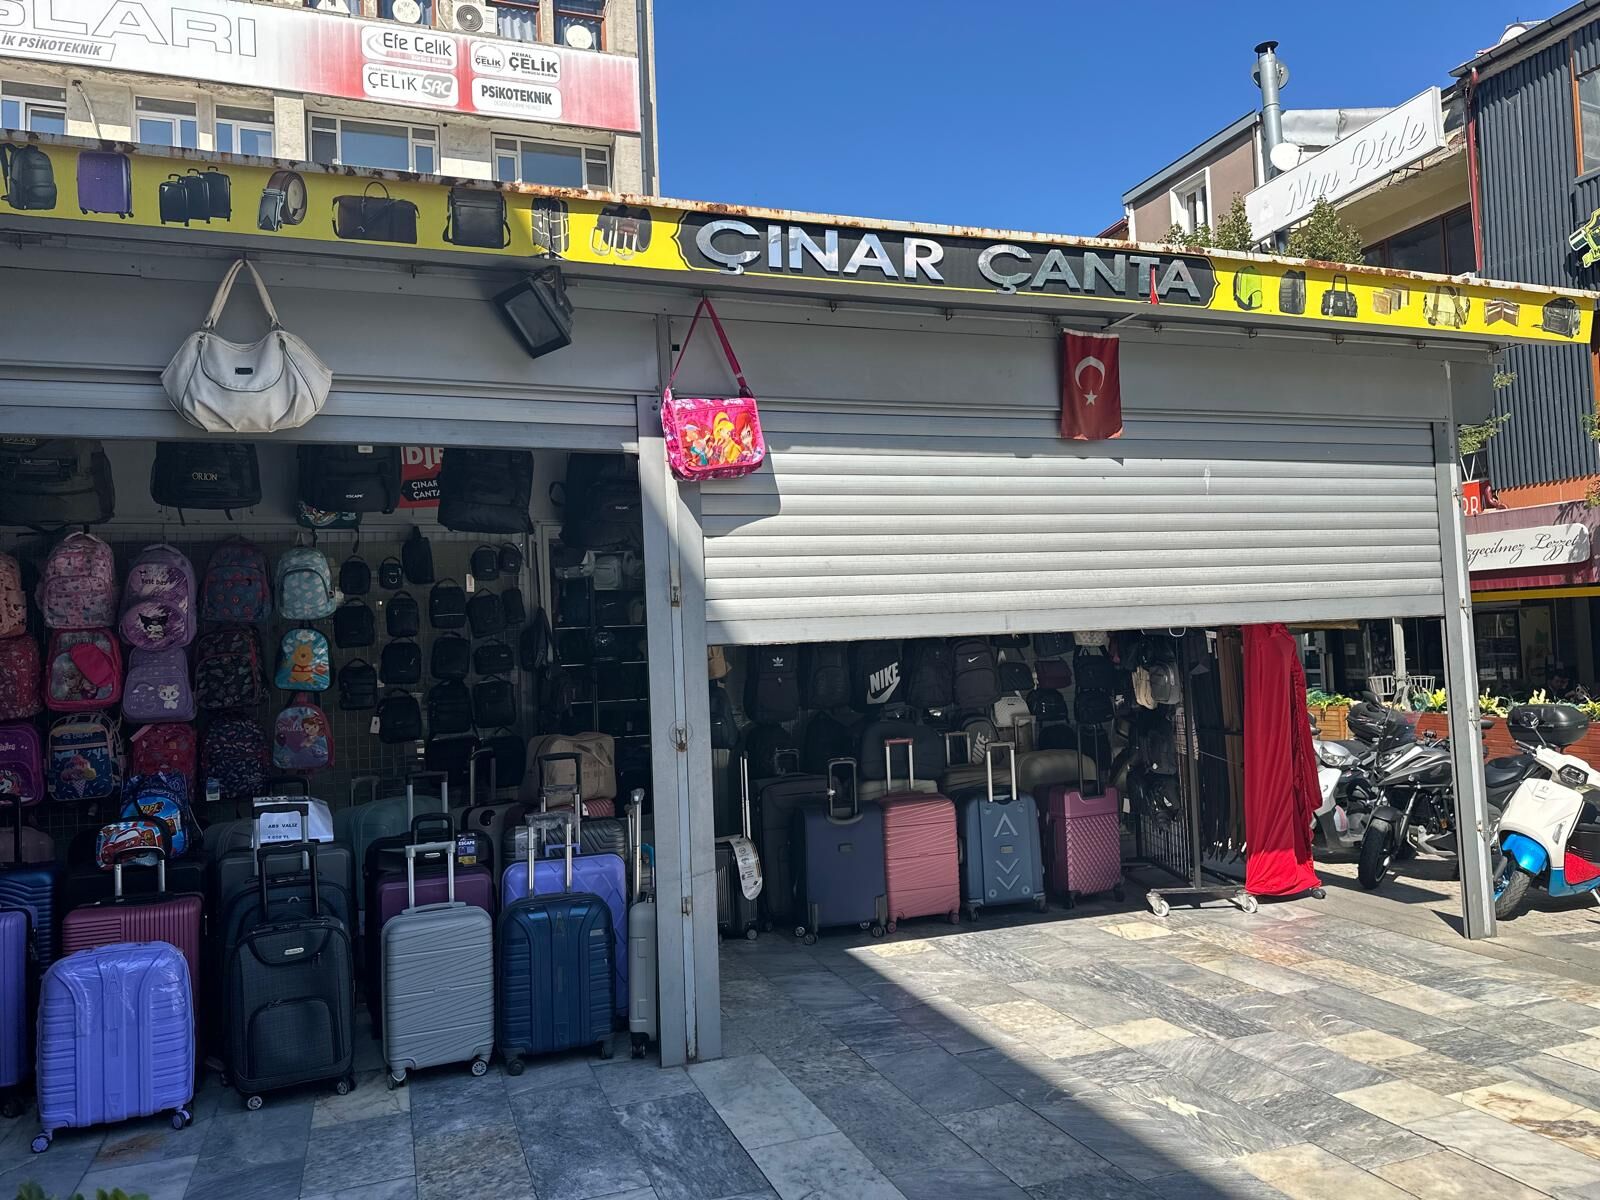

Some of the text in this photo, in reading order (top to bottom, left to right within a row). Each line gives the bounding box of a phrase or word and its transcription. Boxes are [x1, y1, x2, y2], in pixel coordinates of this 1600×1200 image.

[383, 32, 408, 51] Efe
[475, 57, 501, 67] ÇELİK
[508, 57, 558, 74] ÇELİK
[1350, 115, 1427, 184] Pide
[695, 219, 1201, 299] ÇINAR ÇANTA
[191, 471, 218, 481] ORION
[869, 661, 899, 694] NIKE
